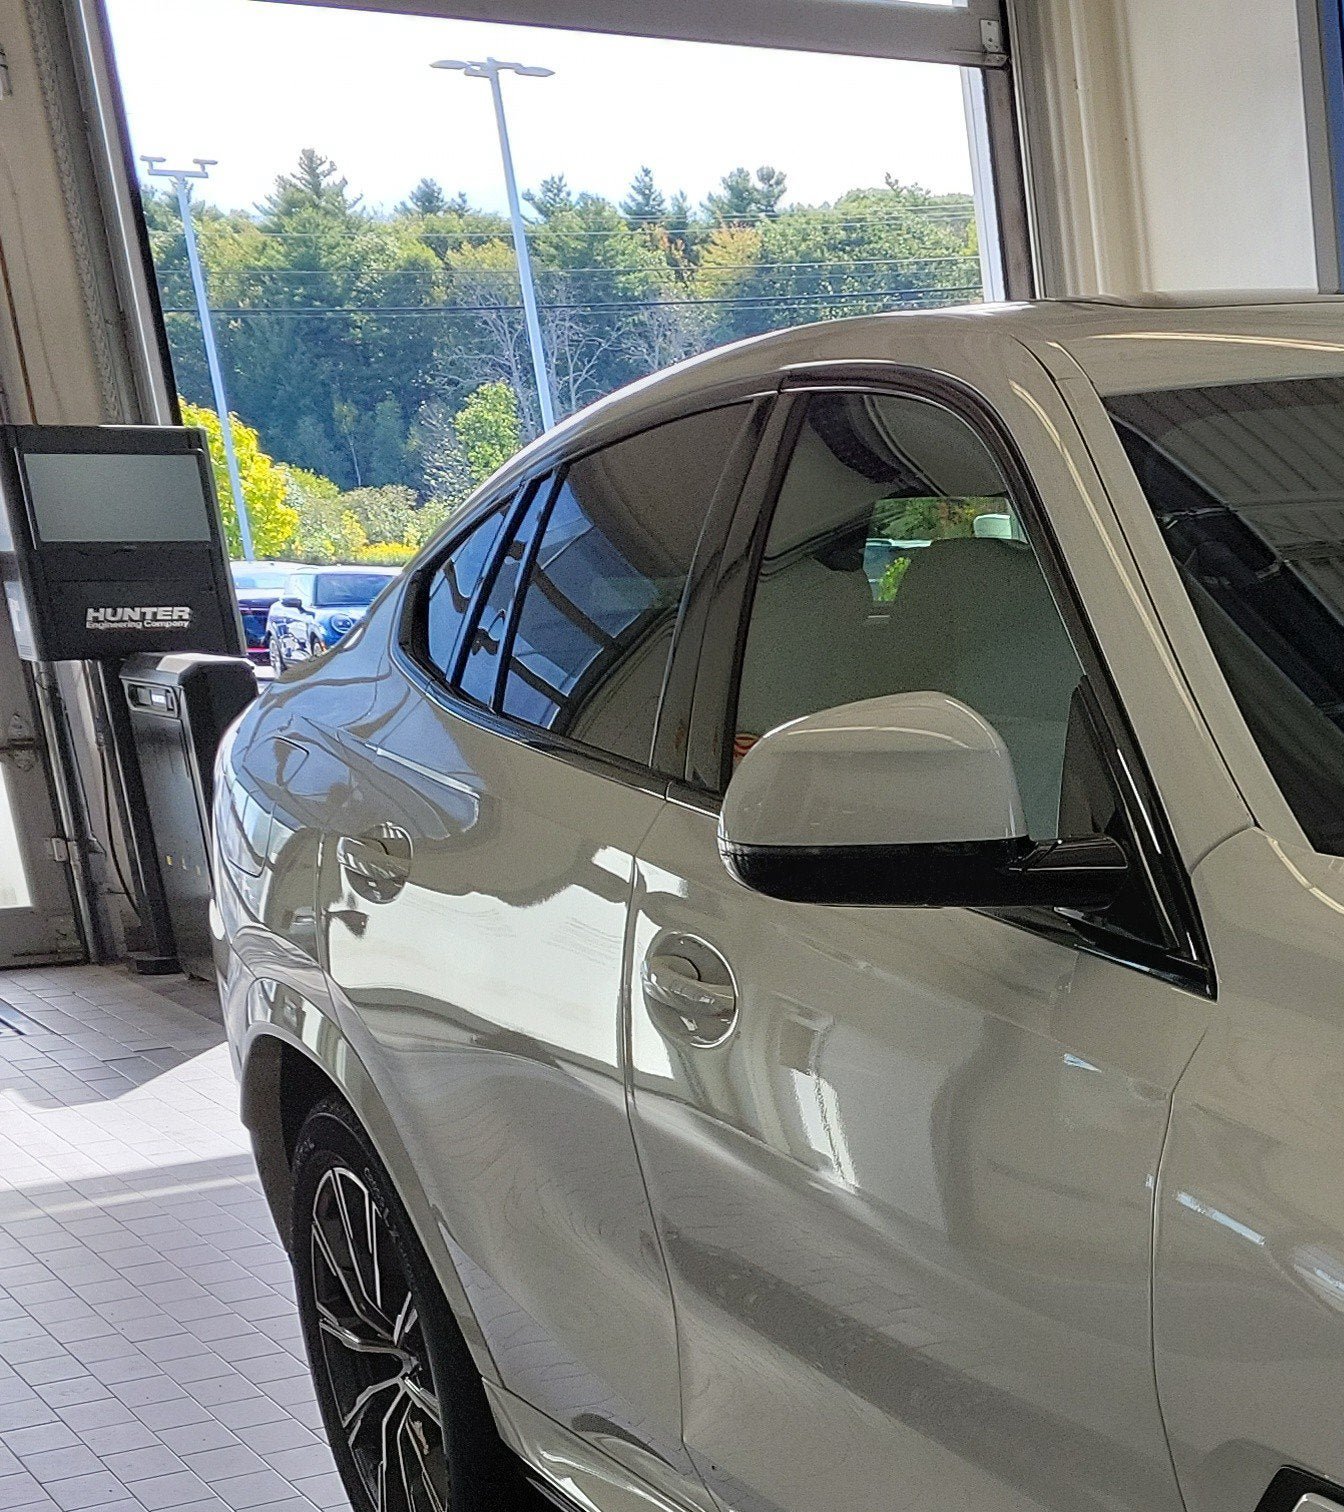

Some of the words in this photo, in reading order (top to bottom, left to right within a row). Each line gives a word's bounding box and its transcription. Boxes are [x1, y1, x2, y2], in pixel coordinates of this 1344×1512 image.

[86, 606, 191, 621] HUNTER
[86, 620, 143, 630] Engineering
[144, 620, 190, 629] Company
